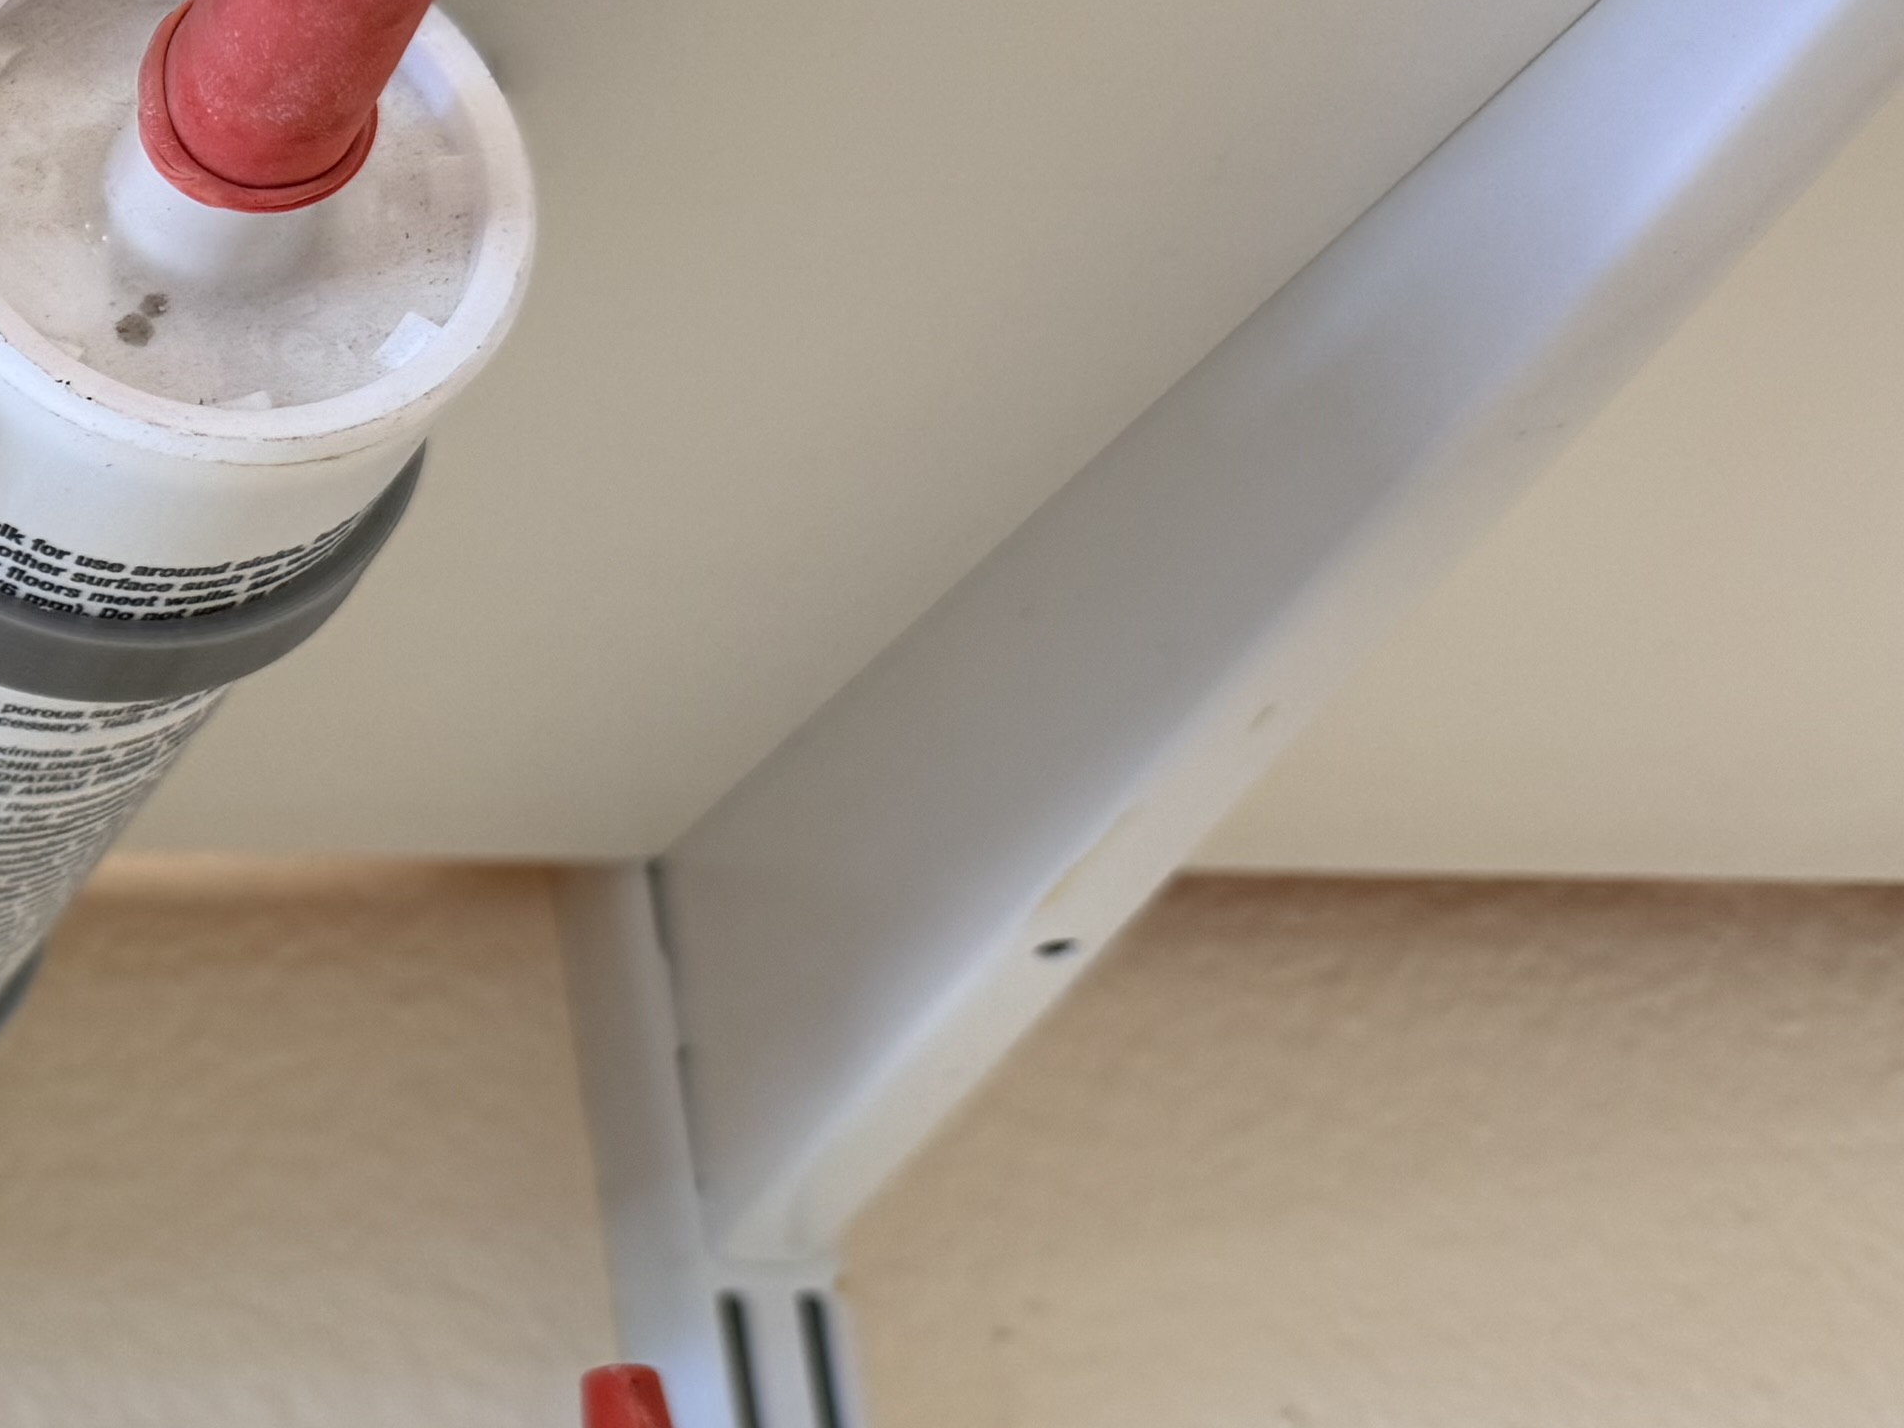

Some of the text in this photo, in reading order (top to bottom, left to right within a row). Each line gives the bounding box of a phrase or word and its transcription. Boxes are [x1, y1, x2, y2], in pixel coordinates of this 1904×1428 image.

[31, 538, 71, 562] for
[75, 555, 125, 573] use
[131, 562, 233, 578] around
[7, 565, 82, 599] floors
[88, 591, 158, 607] meet
[71, 572, 173, 594] surface
[179, 574, 243, 593] such
[99, 607, 134, 621] Do
